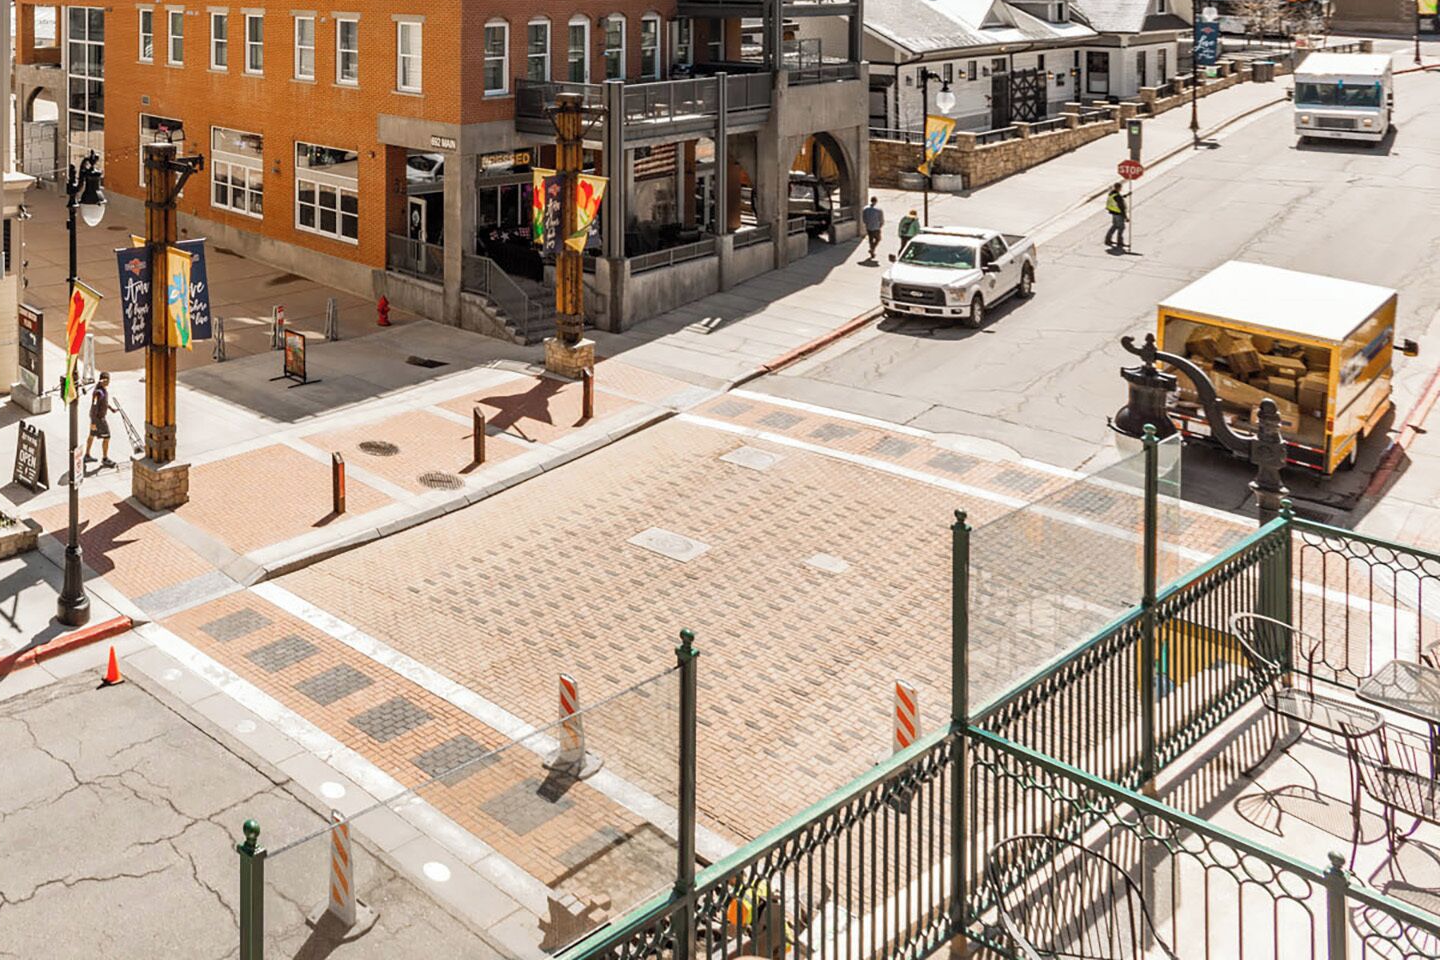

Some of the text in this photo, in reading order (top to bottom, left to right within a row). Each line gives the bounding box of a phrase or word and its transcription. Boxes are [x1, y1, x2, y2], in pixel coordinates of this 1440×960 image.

[441, 138, 456, 149] MAIN
[1119, 165, 1142, 175] STOP
[19, 450, 36, 468] OPEN
